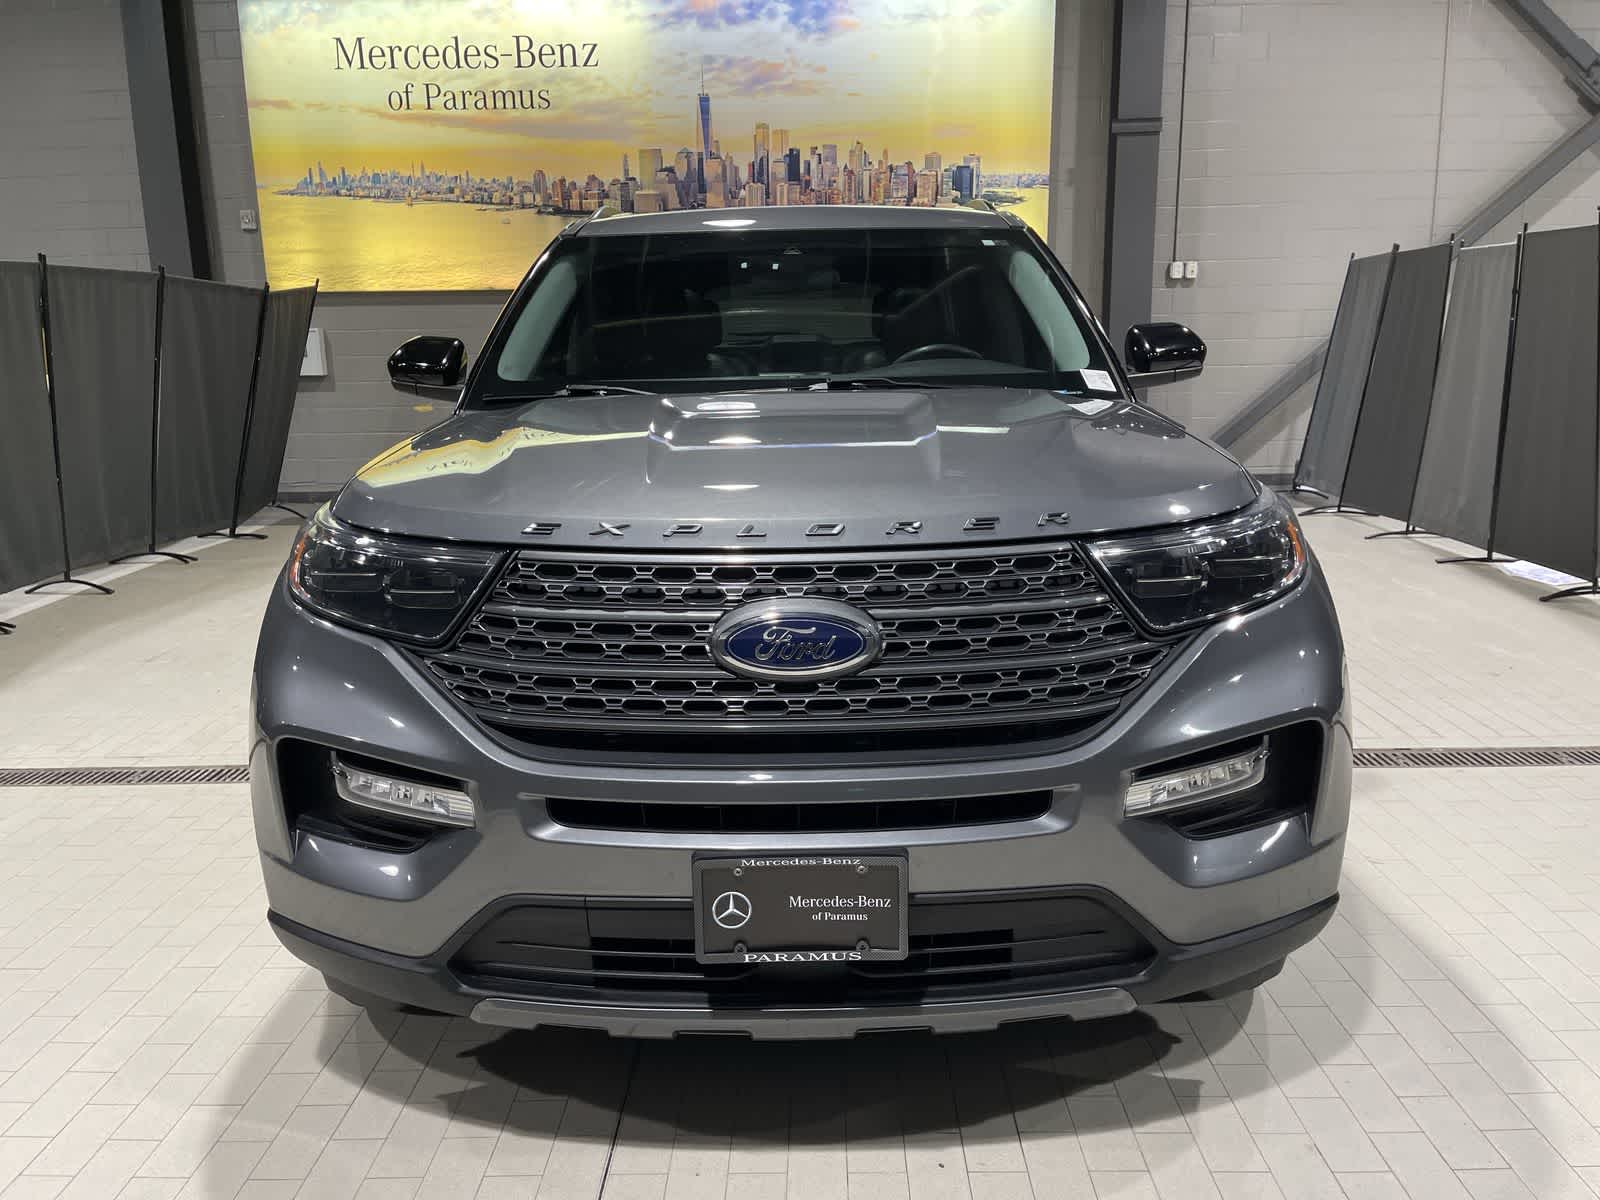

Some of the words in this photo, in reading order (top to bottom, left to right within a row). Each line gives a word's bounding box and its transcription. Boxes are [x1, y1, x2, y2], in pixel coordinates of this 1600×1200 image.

[332, 35, 600, 70] Mercedes-Benz
[387, 82, 414, 111] of
[422, 82, 551, 111] Paramus
[519, 510, 1072, 537] EXPLORER
[753, 625, 838, 662] Ford
[741, 857, 862, 867] Mercedes-Benz
[789, 895, 892, 908] Mercedes-Benz
[812, 912, 823, 921] of
[824, 912, 868, 921] Paramus
[743, 951, 862, 963] PARAMUS
